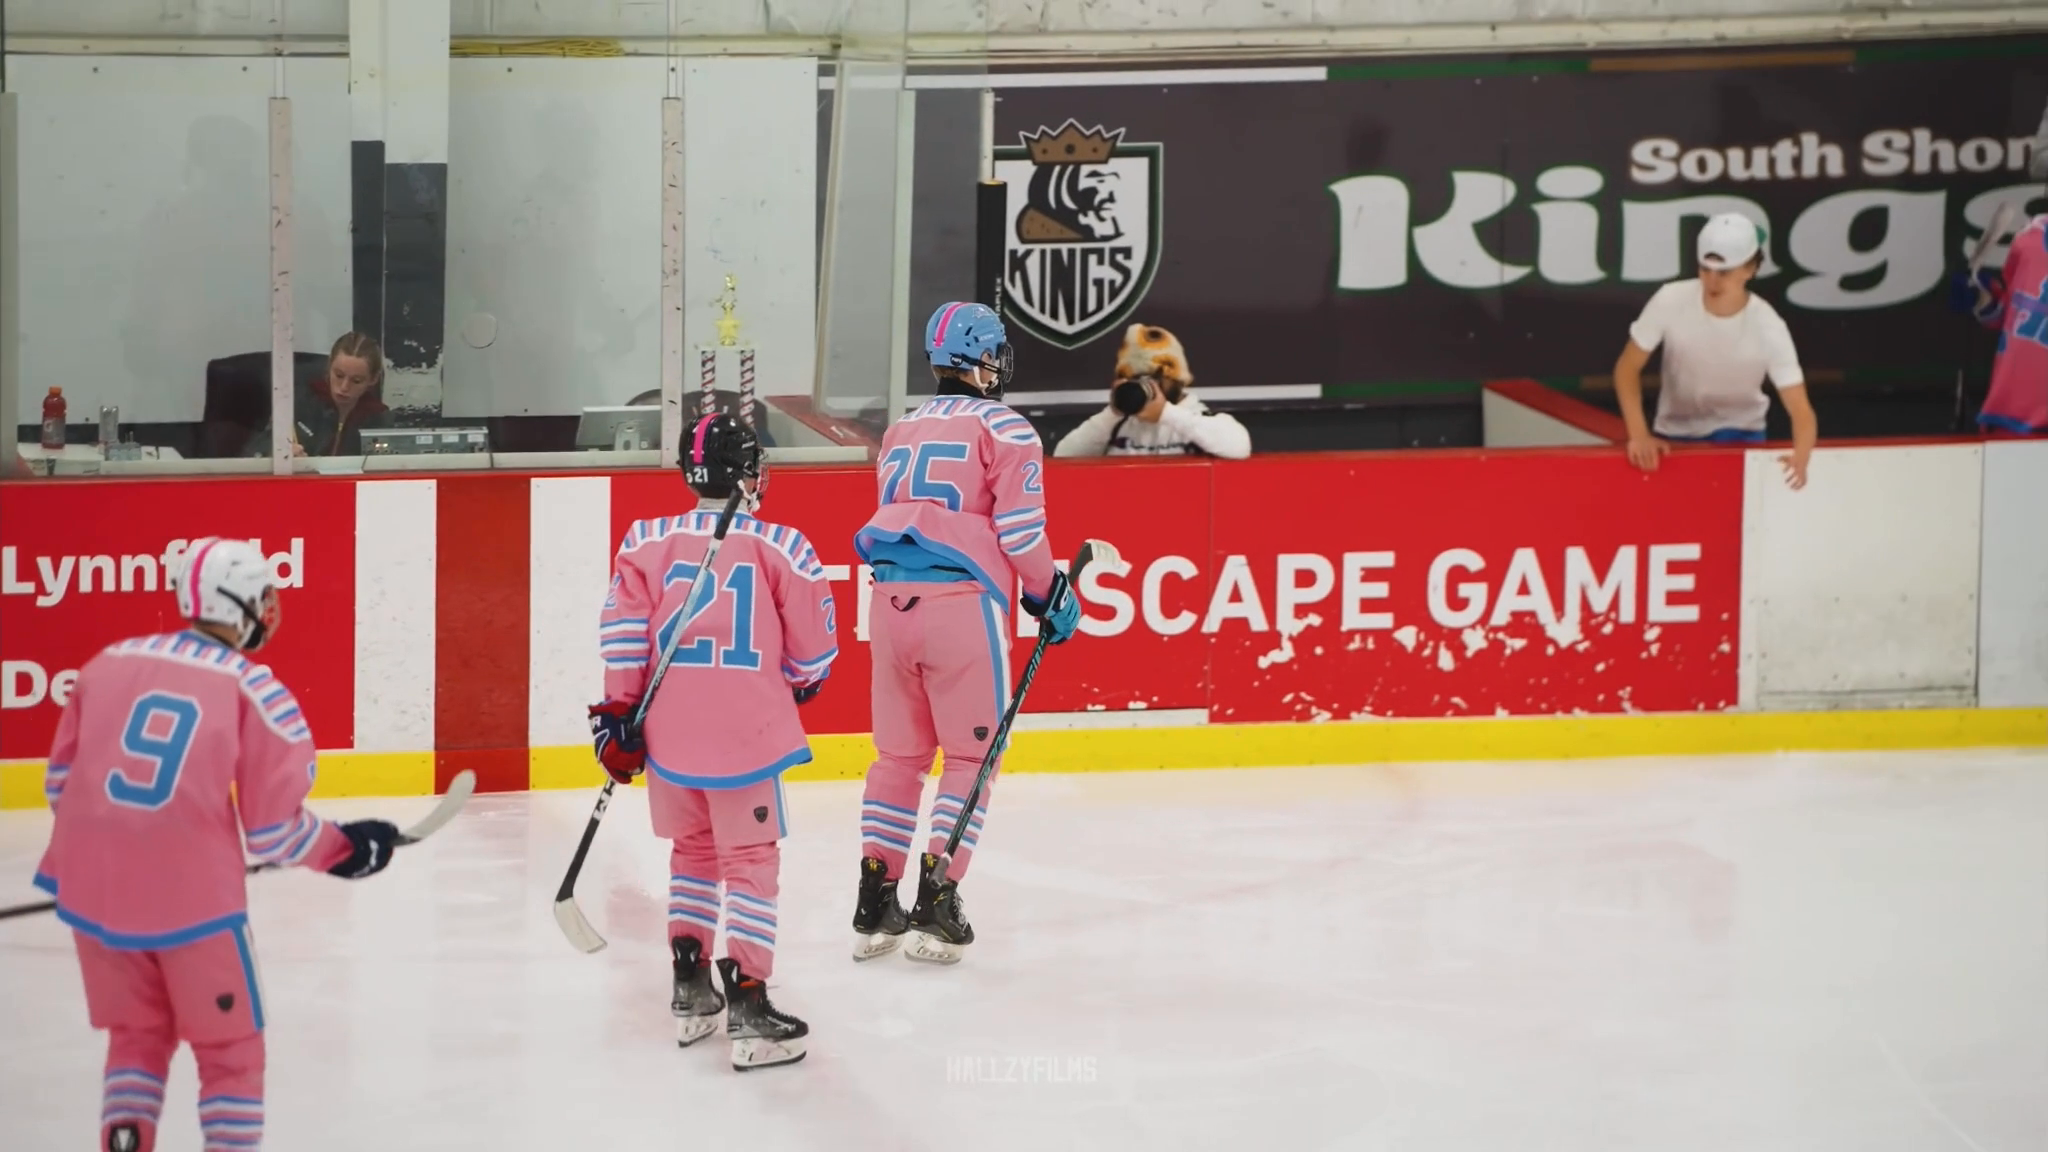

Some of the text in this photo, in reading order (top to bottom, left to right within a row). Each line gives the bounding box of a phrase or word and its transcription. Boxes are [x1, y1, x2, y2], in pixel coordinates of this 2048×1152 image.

[1630, 126, 2048, 184] South Shor
[1008, 247, 1133, 326] KINGS
[693, 466, 709, 483] 21
[1, 538, 304, 606] Lynnfd
[1426, 542, 1703, 629] GAME
[656, 560, 762, 671] 21
[105, 690, 202, 811] 9
